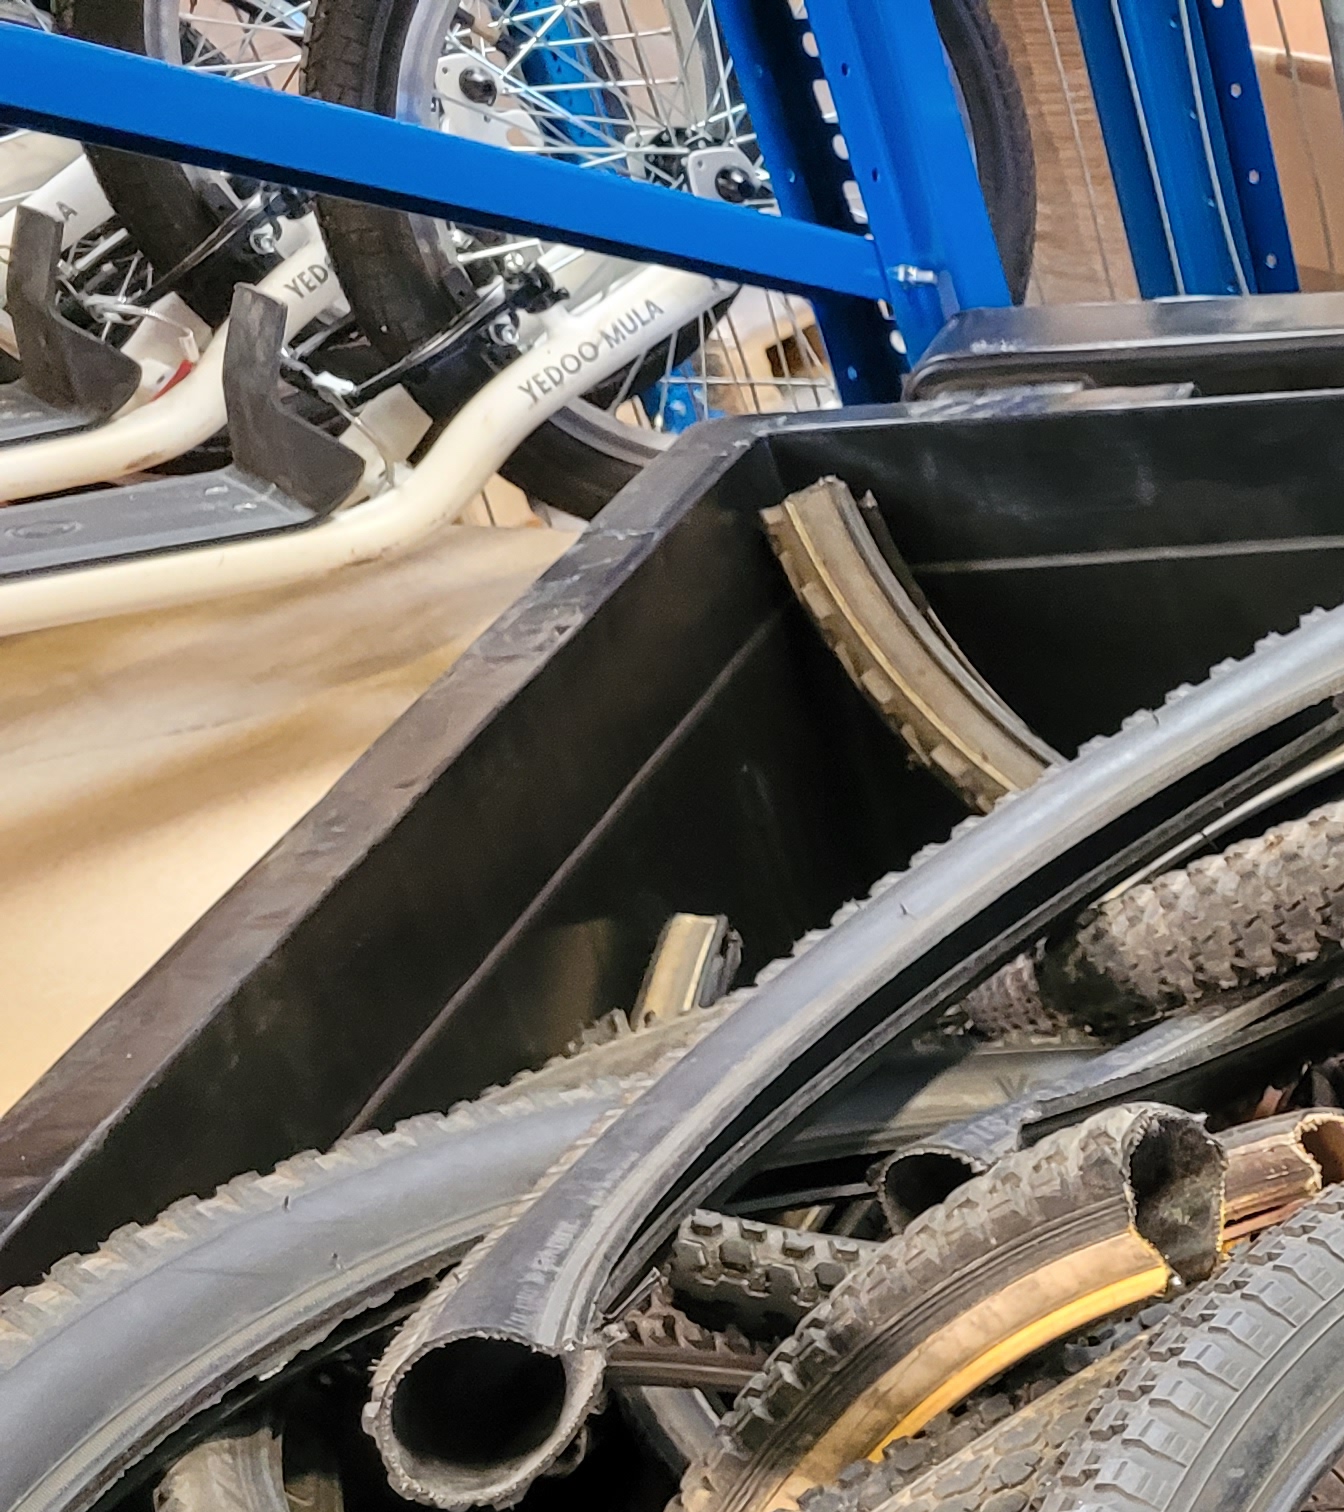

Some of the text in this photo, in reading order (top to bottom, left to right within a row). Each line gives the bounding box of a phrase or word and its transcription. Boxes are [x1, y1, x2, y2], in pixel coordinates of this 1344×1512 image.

[283, 255, 332, 300] YED
[517, 299, 665, 405] YEDOO MULA
